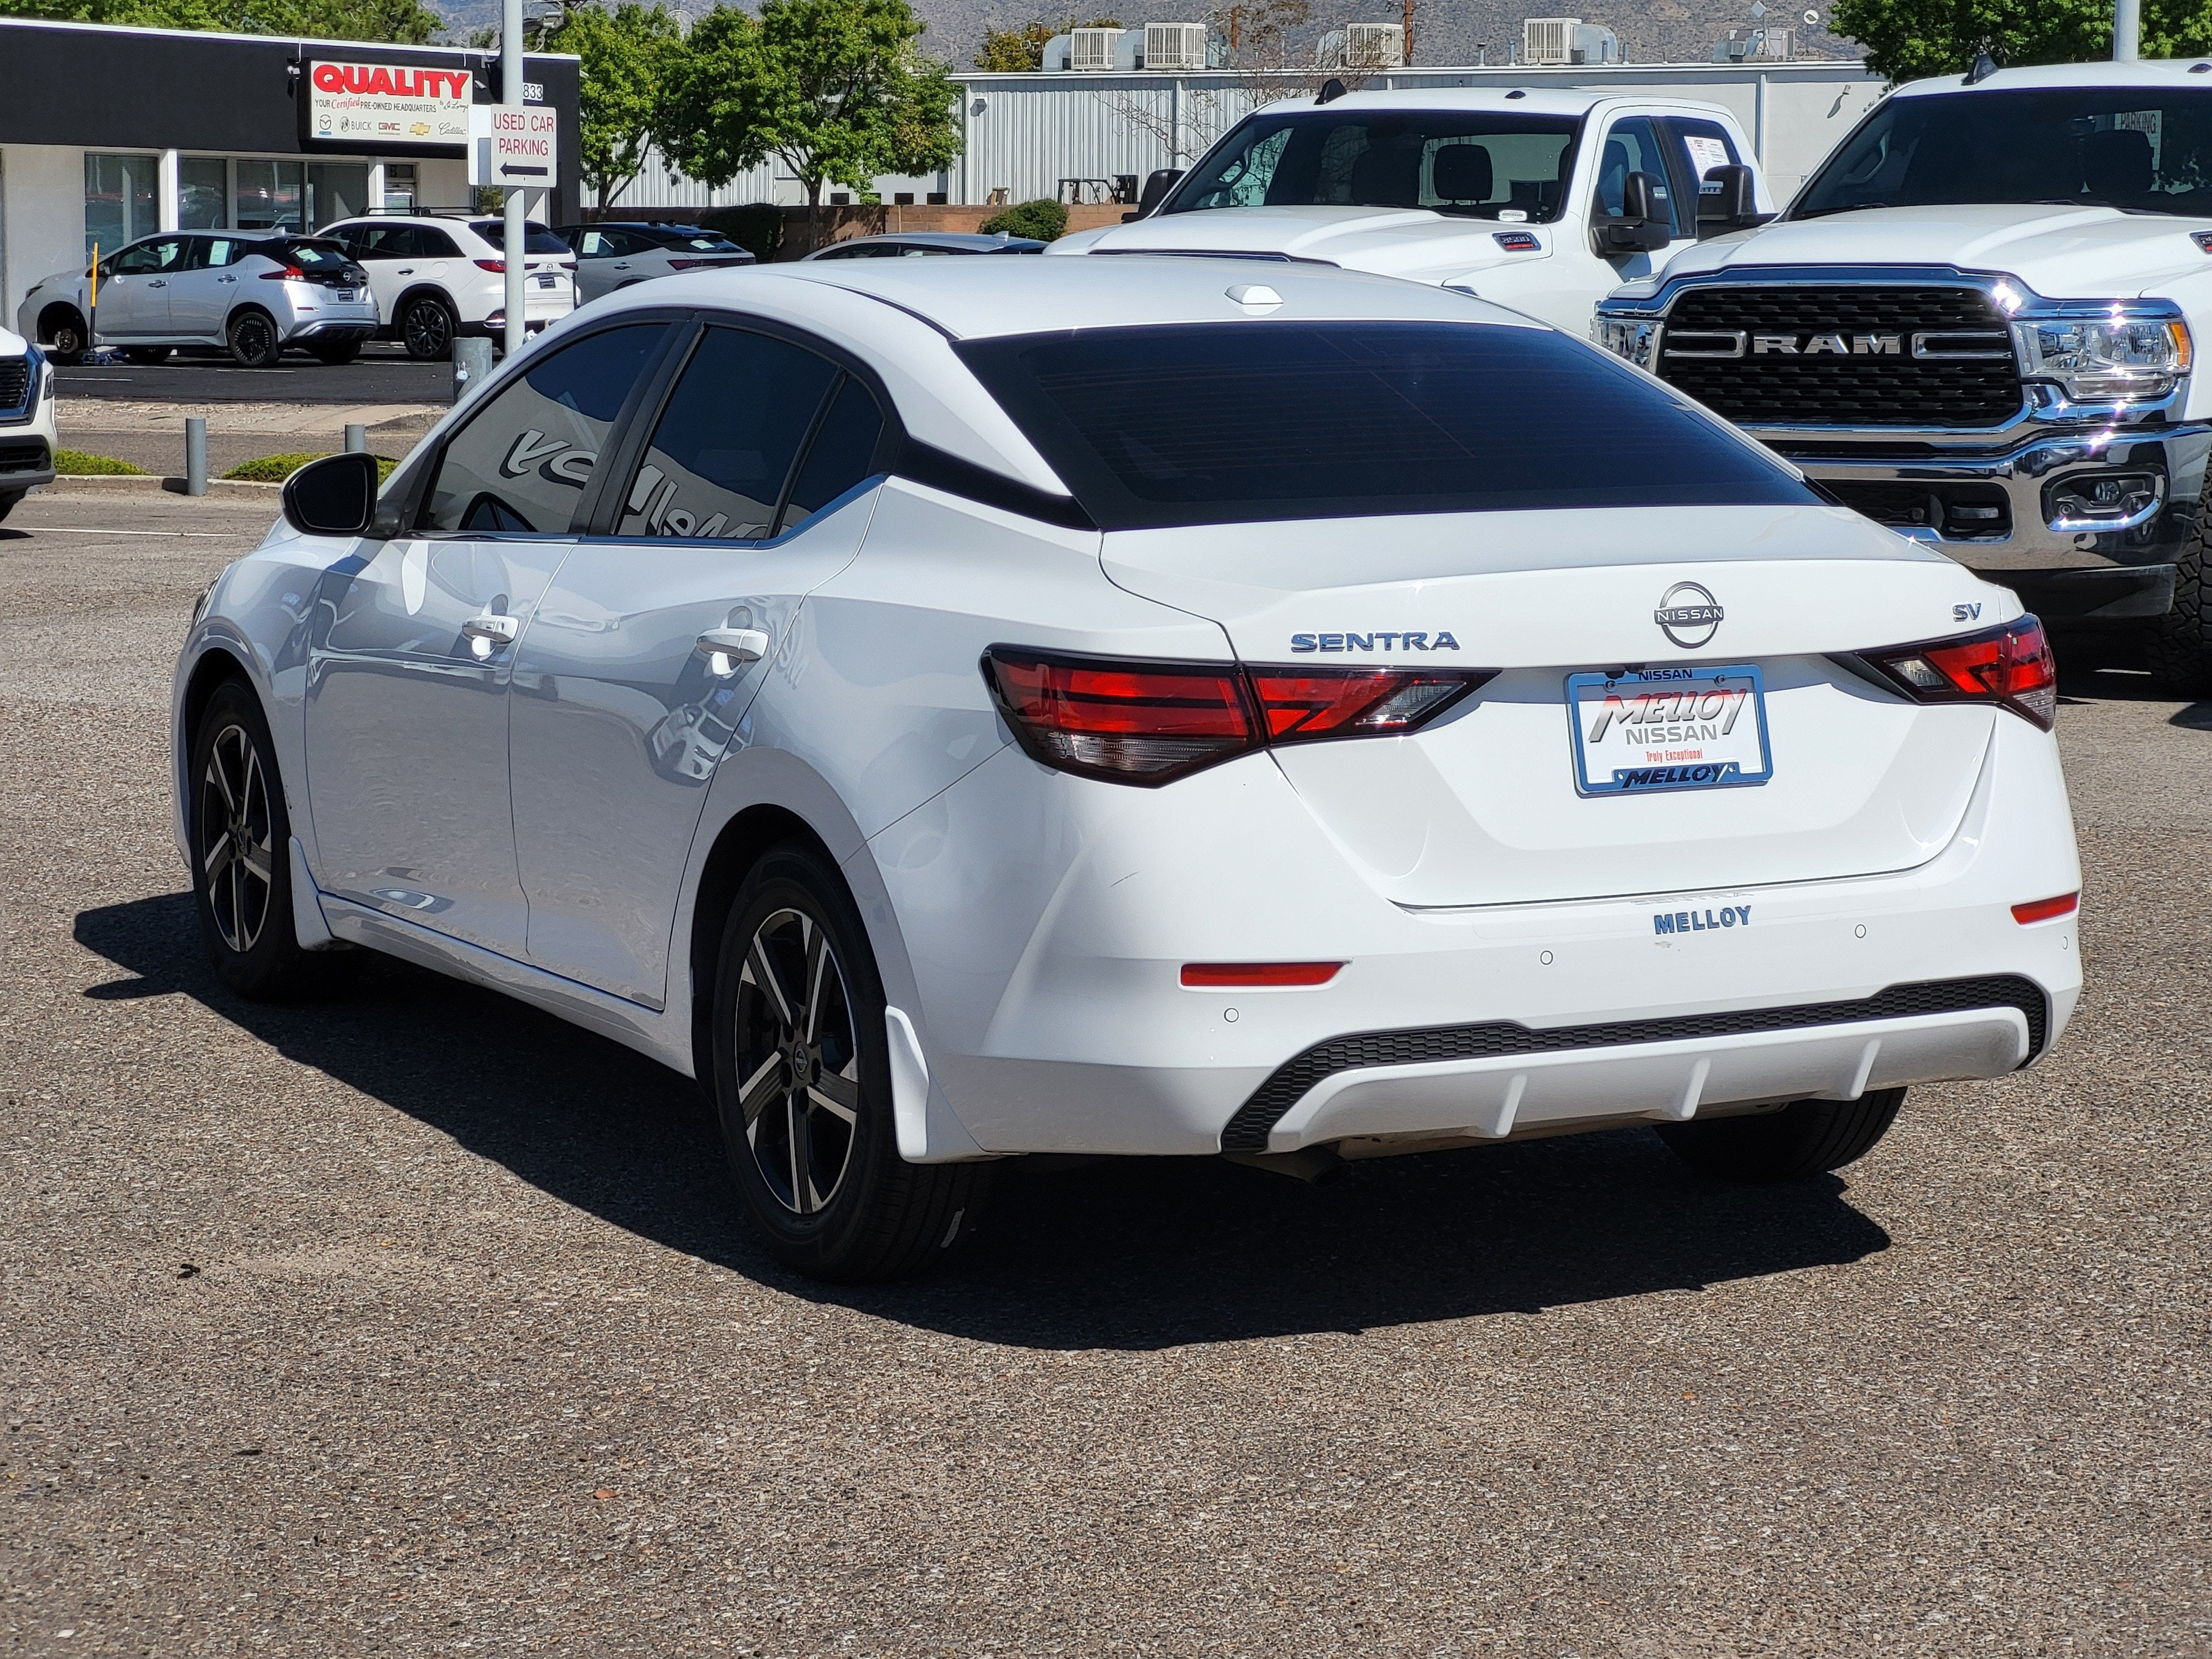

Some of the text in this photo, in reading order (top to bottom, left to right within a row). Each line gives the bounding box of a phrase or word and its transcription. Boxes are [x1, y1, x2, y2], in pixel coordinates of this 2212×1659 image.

[312, 64, 469, 99] QUALITY
[523, 84, 543, 99] 833
[315, 98, 331, 108] YOUR
[331, 96, 360, 110] Certified
[360, 101, 393, 111] PRE-OWNED
[393, 102, 437, 112] HEADQUARTERS
[351, 121, 372, 131] BUICK
[378, 122, 401, 131] GMC
[494, 113, 554, 132] USED CAR
[499, 138, 549, 156] PARKING
[1754, 334, 1902, 354] RAM
[1657, 608, 1723, 622] NISSAN
[1952, 602, 1982, 622] SV
[1291, 632, 1461, 653] SENTRA
[1638, 668, 1693, 681] NISSAN
[1588, 688, 1748, 743] MELLOY
[1625, 724, 1718, 744] NISSAN
[1645, 748, 1703, 763] Truly Exceptional
[1622, 763, 1729, 789] MELLOY
[1653, 905, 1752, 935] MELLOY
